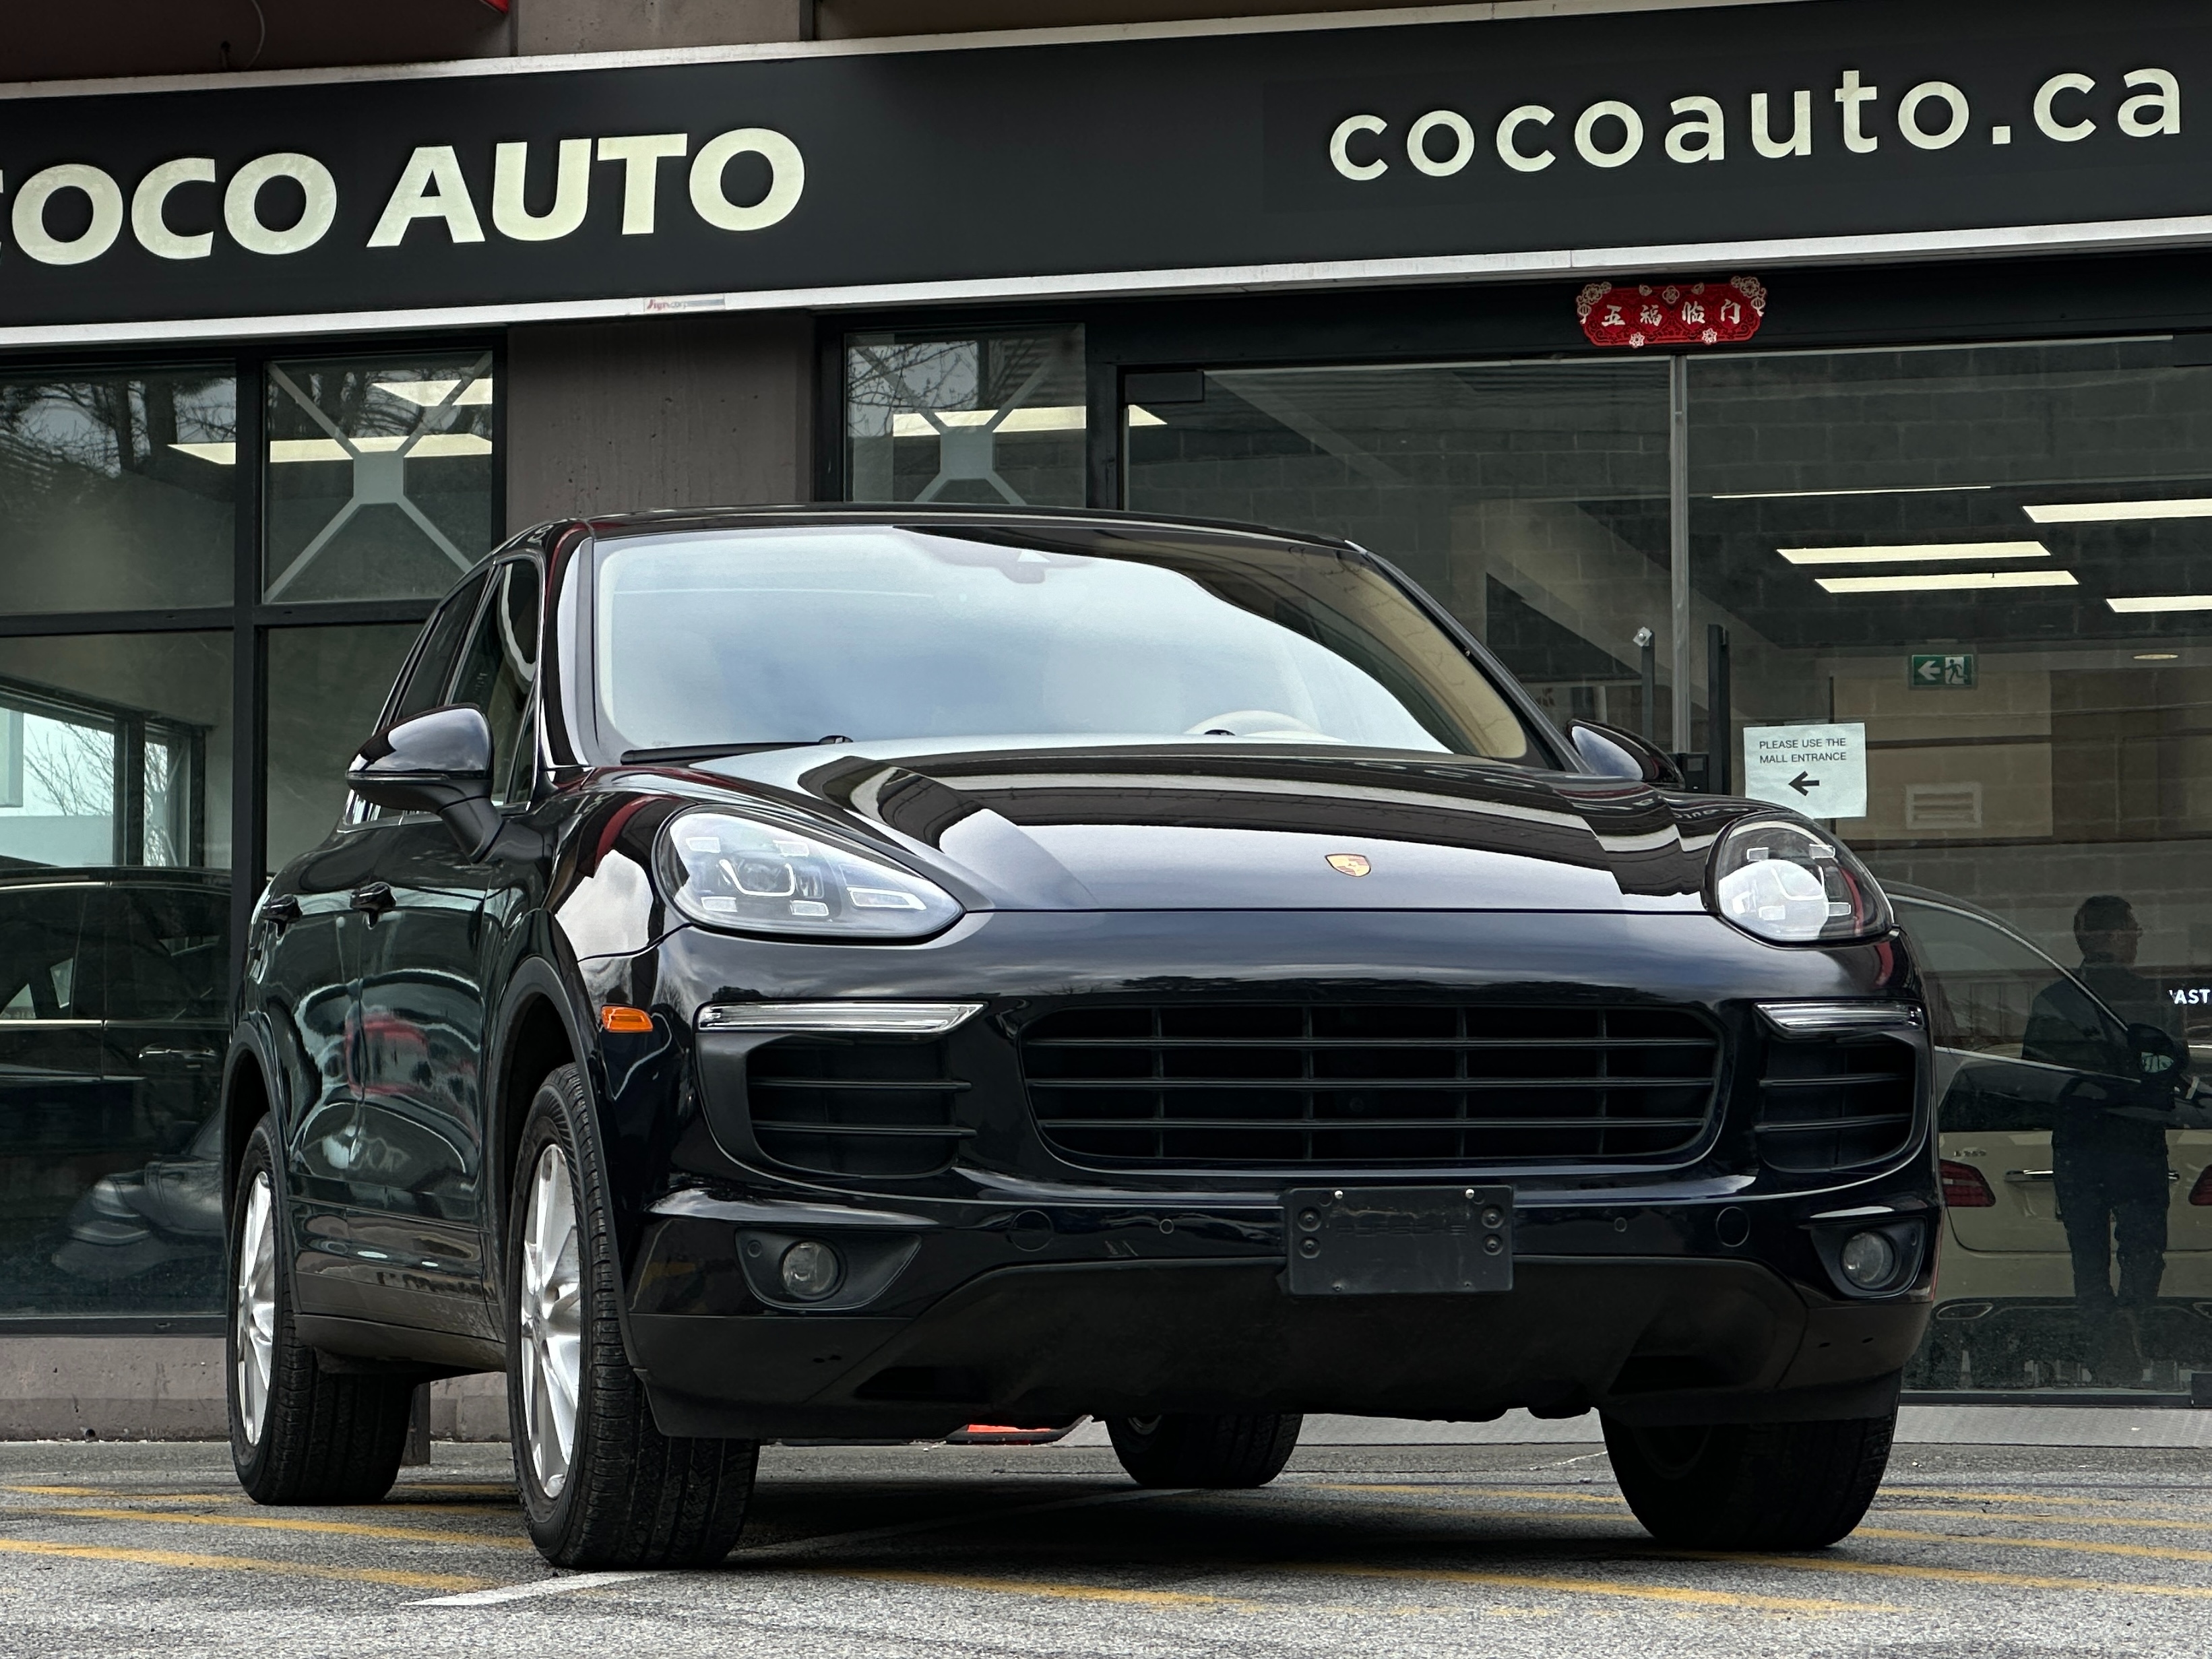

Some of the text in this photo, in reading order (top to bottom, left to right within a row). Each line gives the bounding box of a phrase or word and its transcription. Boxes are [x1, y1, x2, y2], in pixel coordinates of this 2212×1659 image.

[1329, 68, 2180, 181] cocoauto.ca
[0, 127, 805, 266] OCO AUTO
[1601, 299, 1741, 327] 五福临门
[1759, 737, 1846, 749] PLEASE USE THE
[1759, 751, 1846, 763] MALL ENTRANCE
